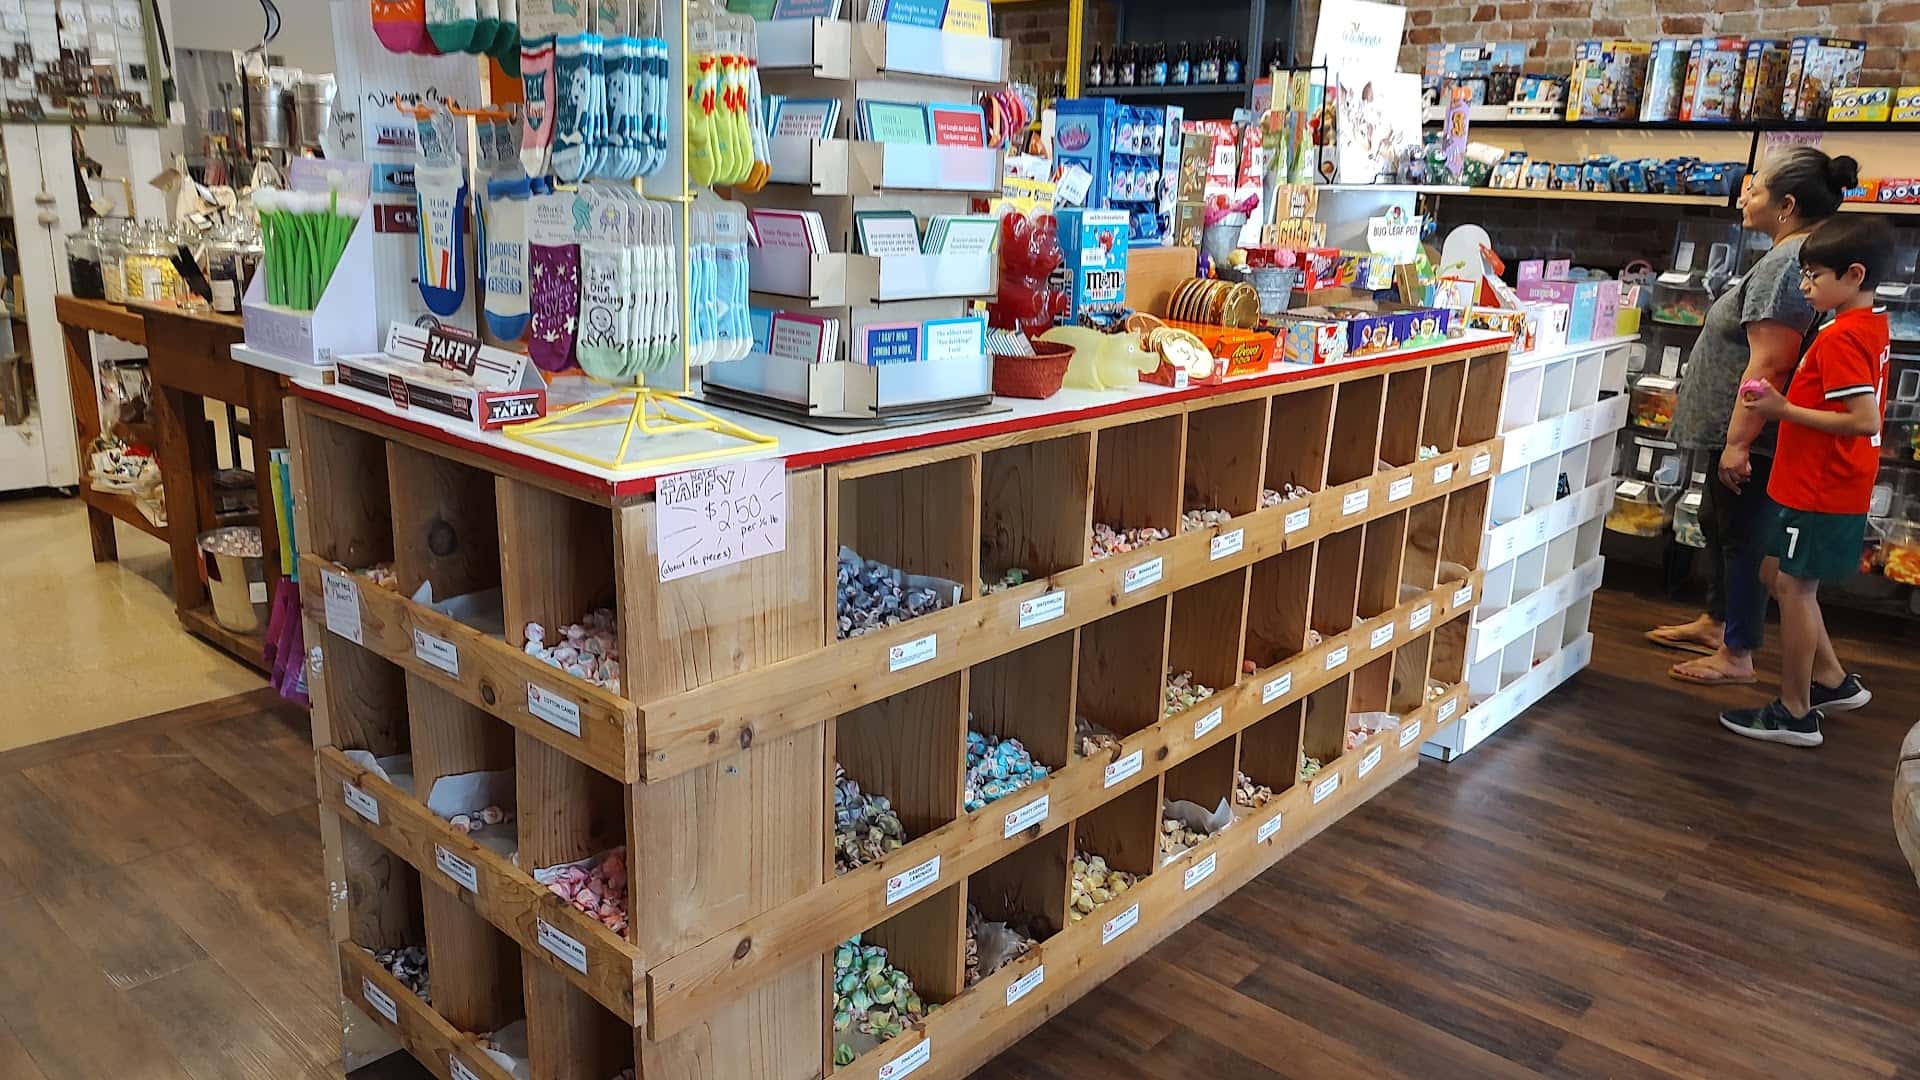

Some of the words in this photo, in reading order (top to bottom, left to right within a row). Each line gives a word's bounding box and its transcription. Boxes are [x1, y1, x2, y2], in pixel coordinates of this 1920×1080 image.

[527, 77, 543, 99] CAT
[1833, 89, 1888, 108] DOTS
[1373, 225, 1387, 237] BUG
[1388, 225, 1404, 237] LEAF
[1405, 225, 1418, 236] PEN
[600, 271, 616, 284] got
[583, 288, 624, 312] brewing
[430, 335, 476, 367] TAFFY
[493, 403, 534, 419] TAFFY
[660, 469, 735, 505] TAFFY
[705, 494, 761, 532] $2.50
[741, 521, 756, 538] per
[1786, 526, 1800, 559] 7
[660, 560, 685, 579] (about
[702, 546, 732, 566] pieces)
